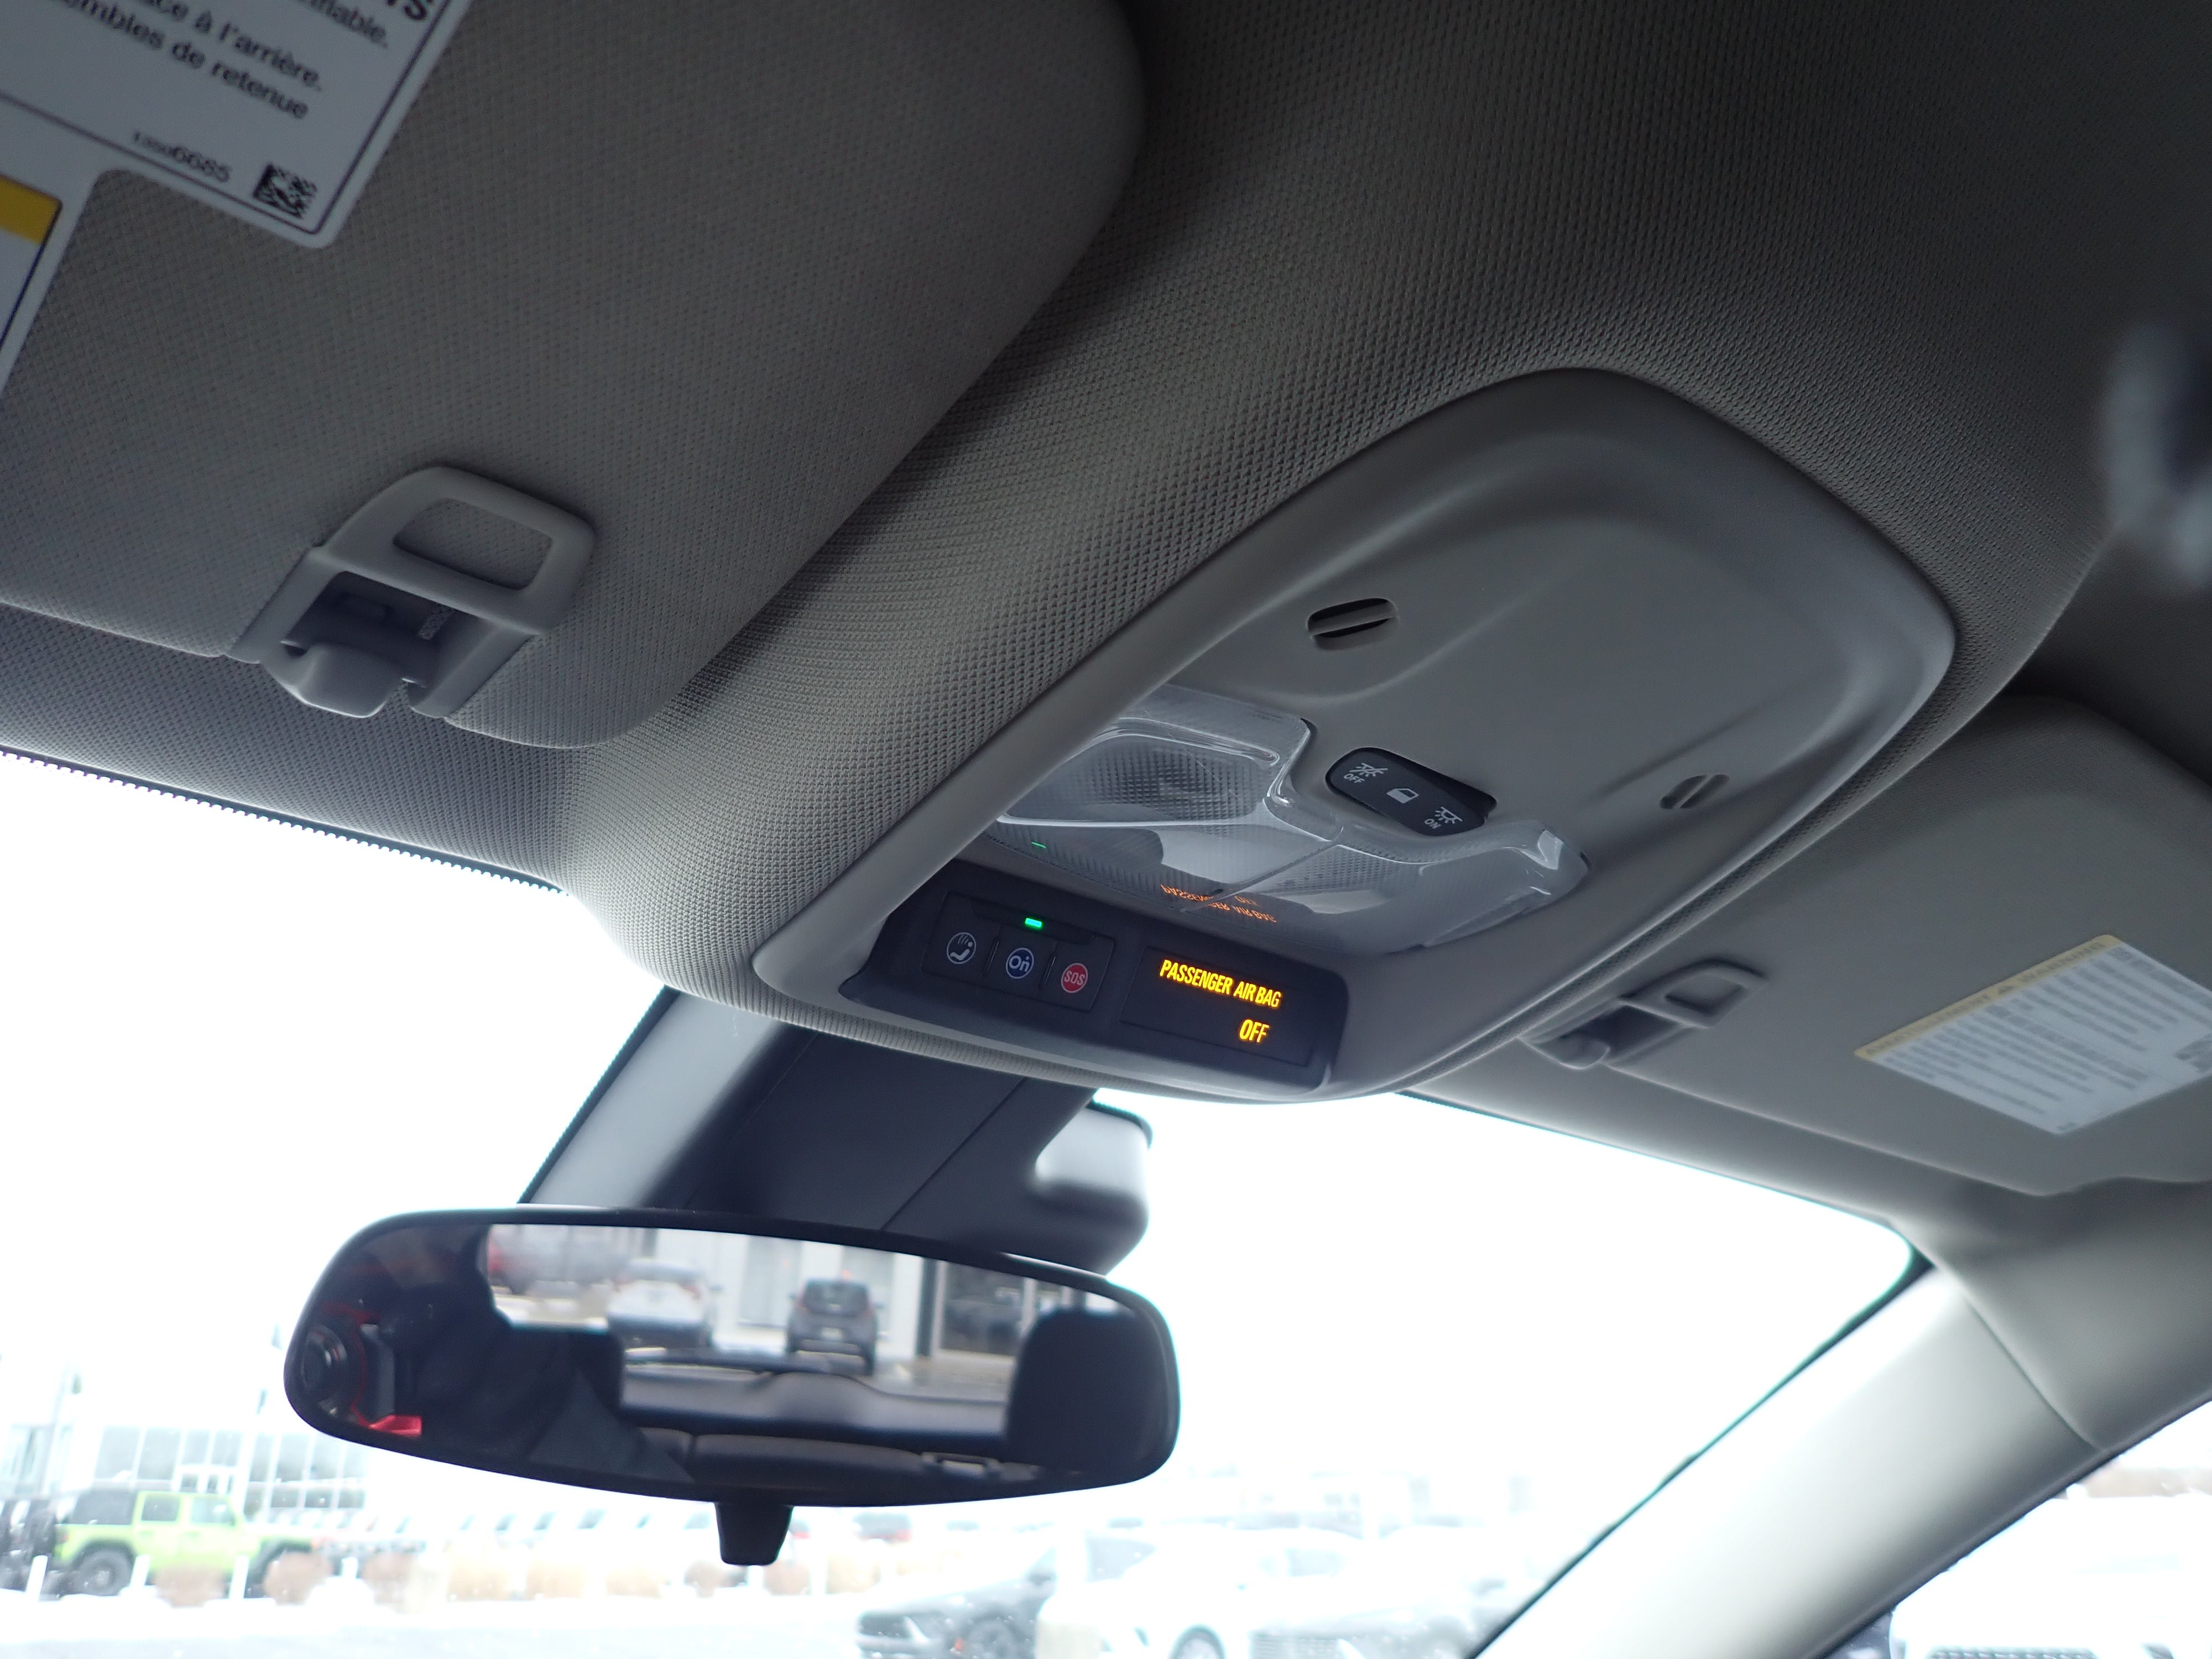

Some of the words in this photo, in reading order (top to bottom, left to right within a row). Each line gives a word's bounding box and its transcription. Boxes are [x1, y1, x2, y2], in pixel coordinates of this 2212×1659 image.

[194, 10, 213, 34] à
[172, 41, 205, 70] de
[211, 62, 308, 118] retenue
[1344, 774, 1364, 783] OFF
[1424, 818, 1441, 829] ON
[1064, 971, 1085, 985] SOS
[1159, 959, 1233, 995] PASSENGER
[1233, 981, 1256, 1001] AIR
[1254, 986, 1281, 1008] BAG
[1239, 1019, 1270, 1043] OFF
